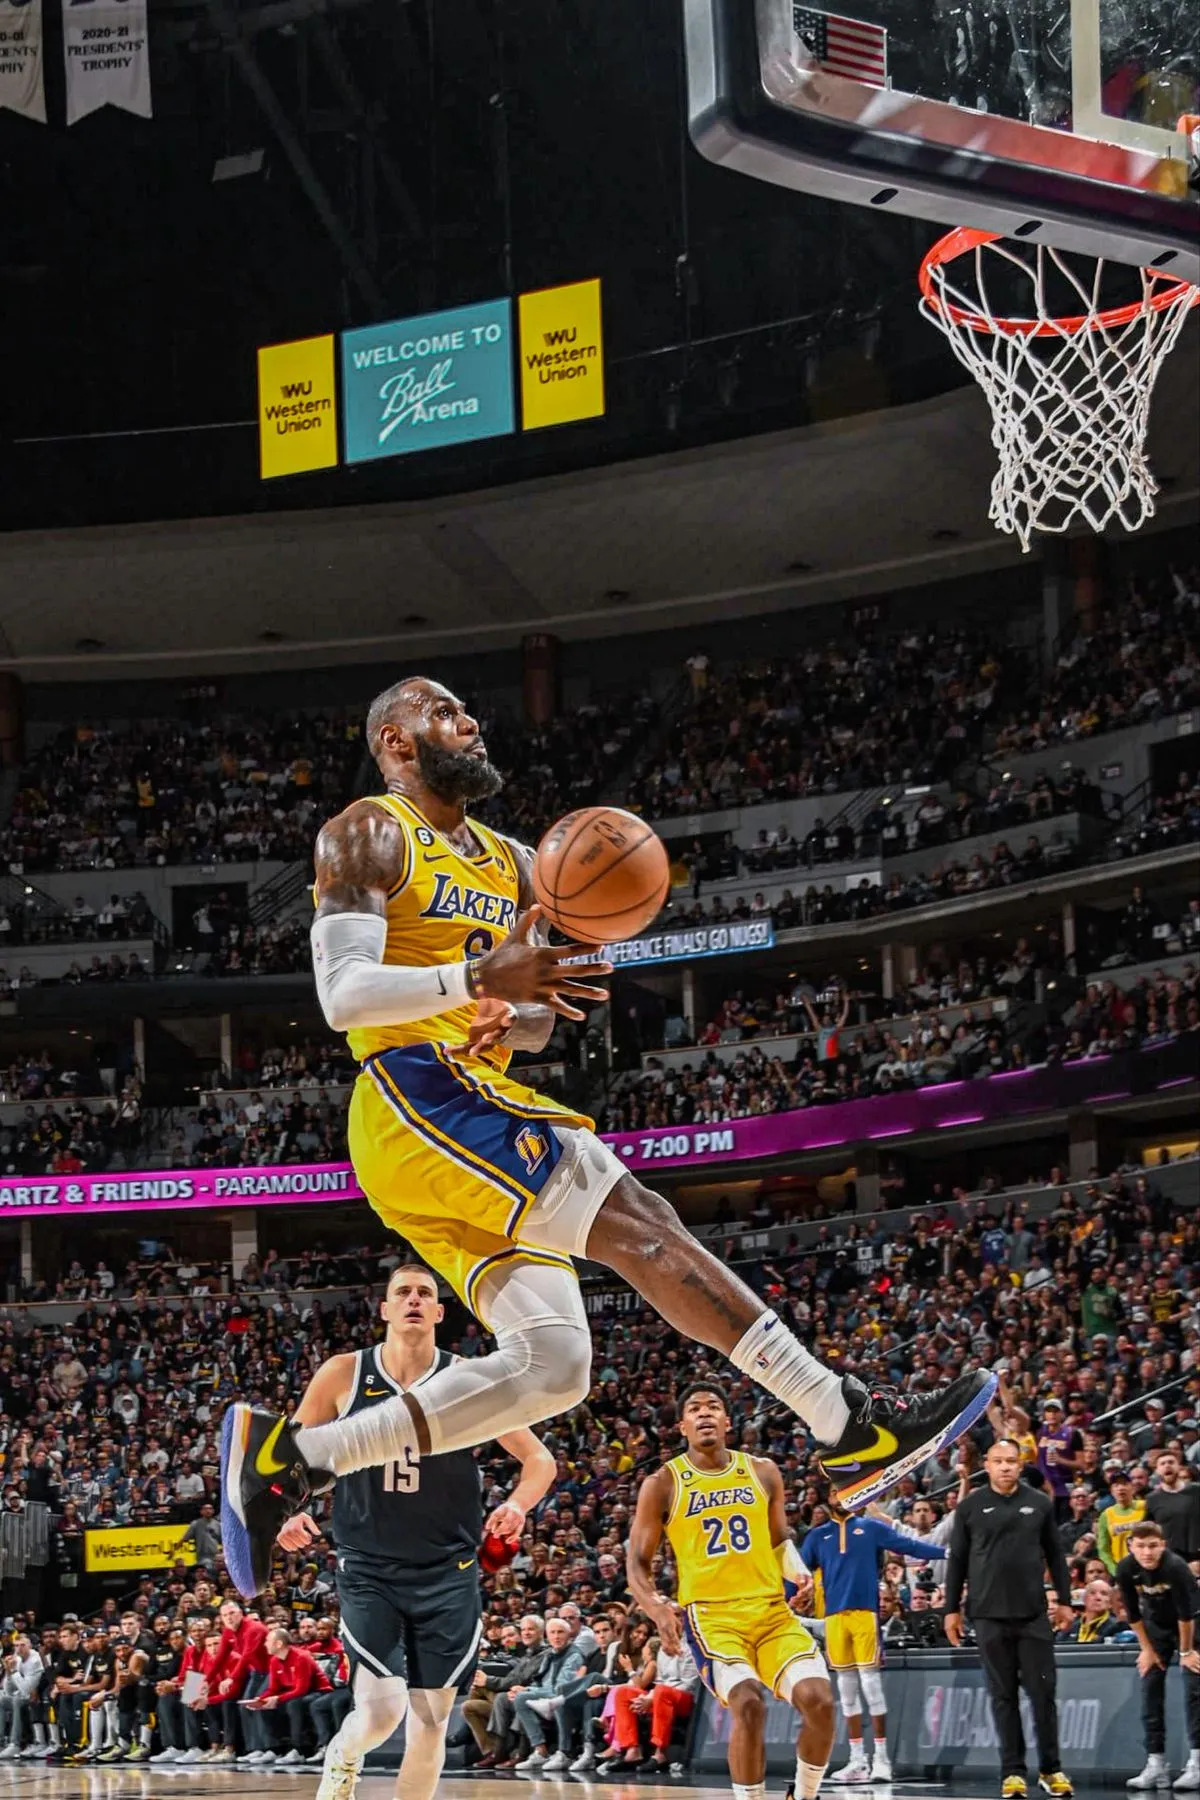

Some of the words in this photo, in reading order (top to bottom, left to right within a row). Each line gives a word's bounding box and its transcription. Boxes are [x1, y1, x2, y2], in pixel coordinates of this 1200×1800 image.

[82, 26, 129, 40] 2020-21
[81, 58, 132, 72] TROPHY
[353, 330, 464, 369] WELCOME
[471, 323, 502, 346] TO
[543, 327, 577, 347] WU
[526, 344, 597, 370] Western
[538, 363, 587, 385] Union
[281, 380, 313, 399] WU
[379, 359, 456, 443] Ball
[265, 396, 331, 421] Western
[412, 397, 479, 426] Arena
[277, 416, 321, 435] Union
[419, 873, 516, 932] LAKER
[709, 928, 728, 950] GO
[640, 1135, 690, 1159] 7:00
[694, 1130, 734, 1153] PM
[65, 1182, 84, 1203] &
[91, 1178, 194, 1202] FRIENDS
[215, 1170, 350, 1196] PARAMOUNT
[365, 1374, 375, 1385] 6
[384, 1456, 420, 1493] 15
[684, 1486, 756, 1518] LAKERS
[702, 1513, 751, 1559] 28
